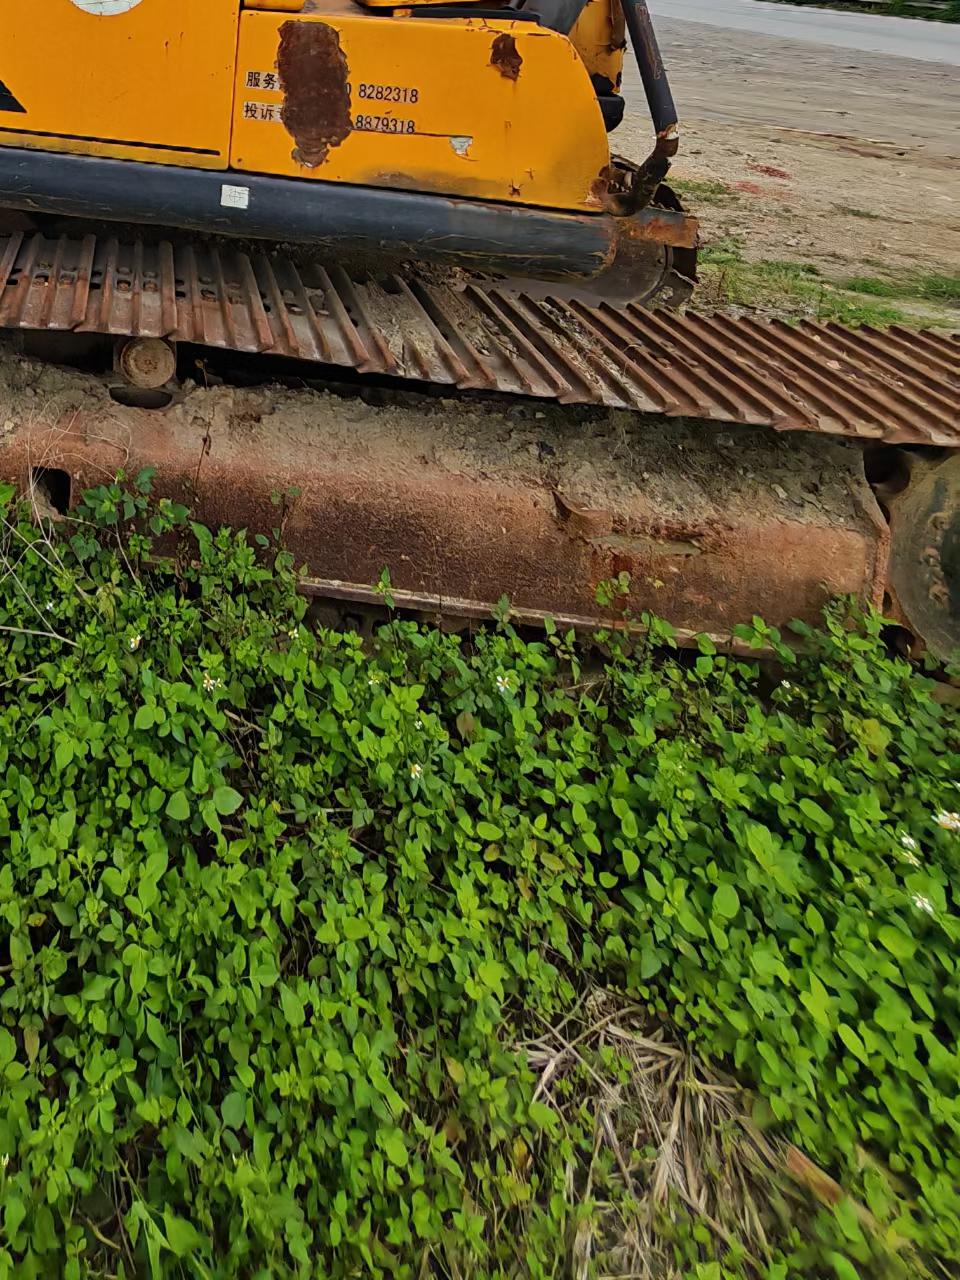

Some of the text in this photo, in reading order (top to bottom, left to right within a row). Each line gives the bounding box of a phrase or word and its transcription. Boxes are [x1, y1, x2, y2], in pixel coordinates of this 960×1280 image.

[358, 83, 418, 104] 8282318
[244, 102, 283, 120] 投诉
[355, 114, 415, 133] 8879318
